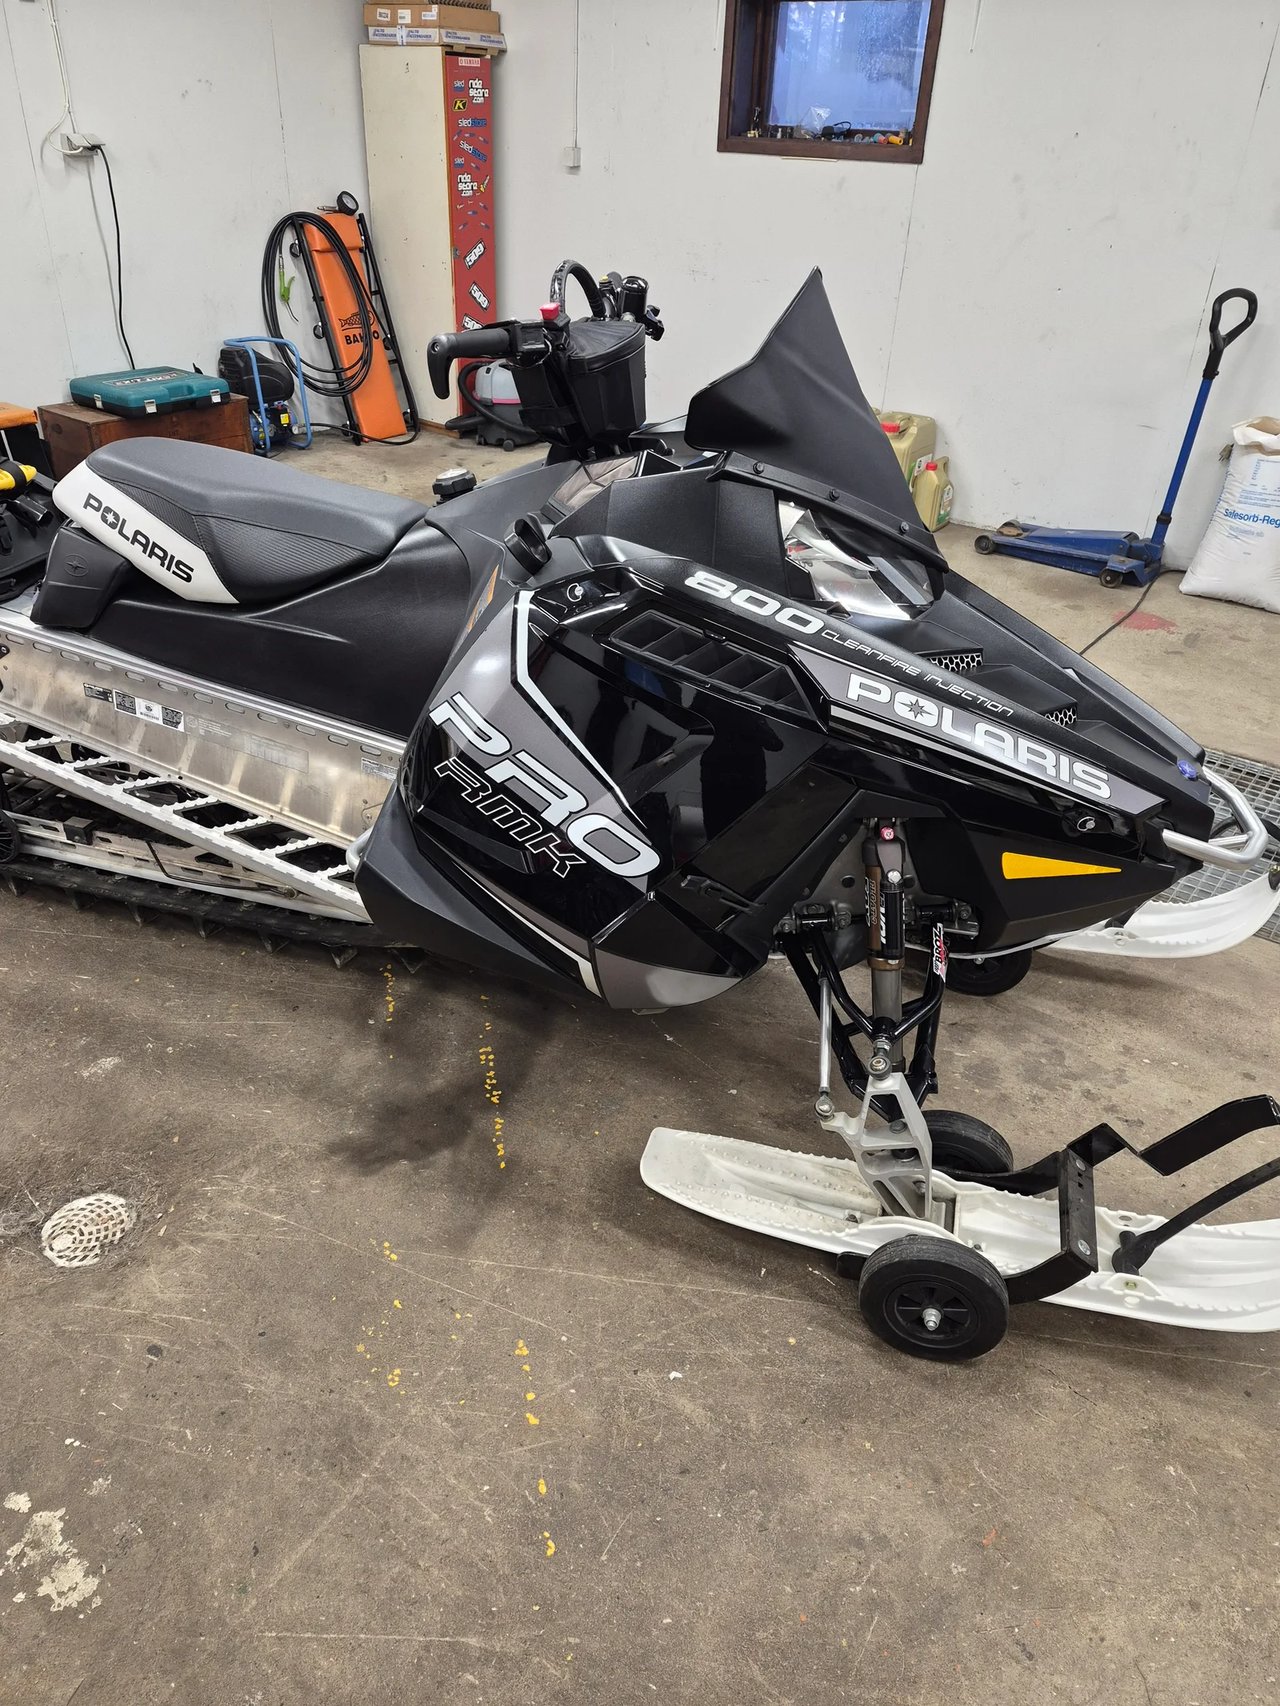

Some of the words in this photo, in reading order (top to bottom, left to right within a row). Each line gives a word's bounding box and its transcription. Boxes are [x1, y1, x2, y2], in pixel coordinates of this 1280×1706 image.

[465, 242, 485, 267] 509
[471, 284, 489, 308] 509
[344, 329, 380, 345] BAO
[83, 492, 195, 583] POLARIS
[684, 570, 825, 635] 800
[821, 629, 921, 677] CLEANFIRE
[923, 669, 1015, 718] INJECTION
[846, 672, 1112, 800] POLARIS
[428, 691, 661, 878] PRO
